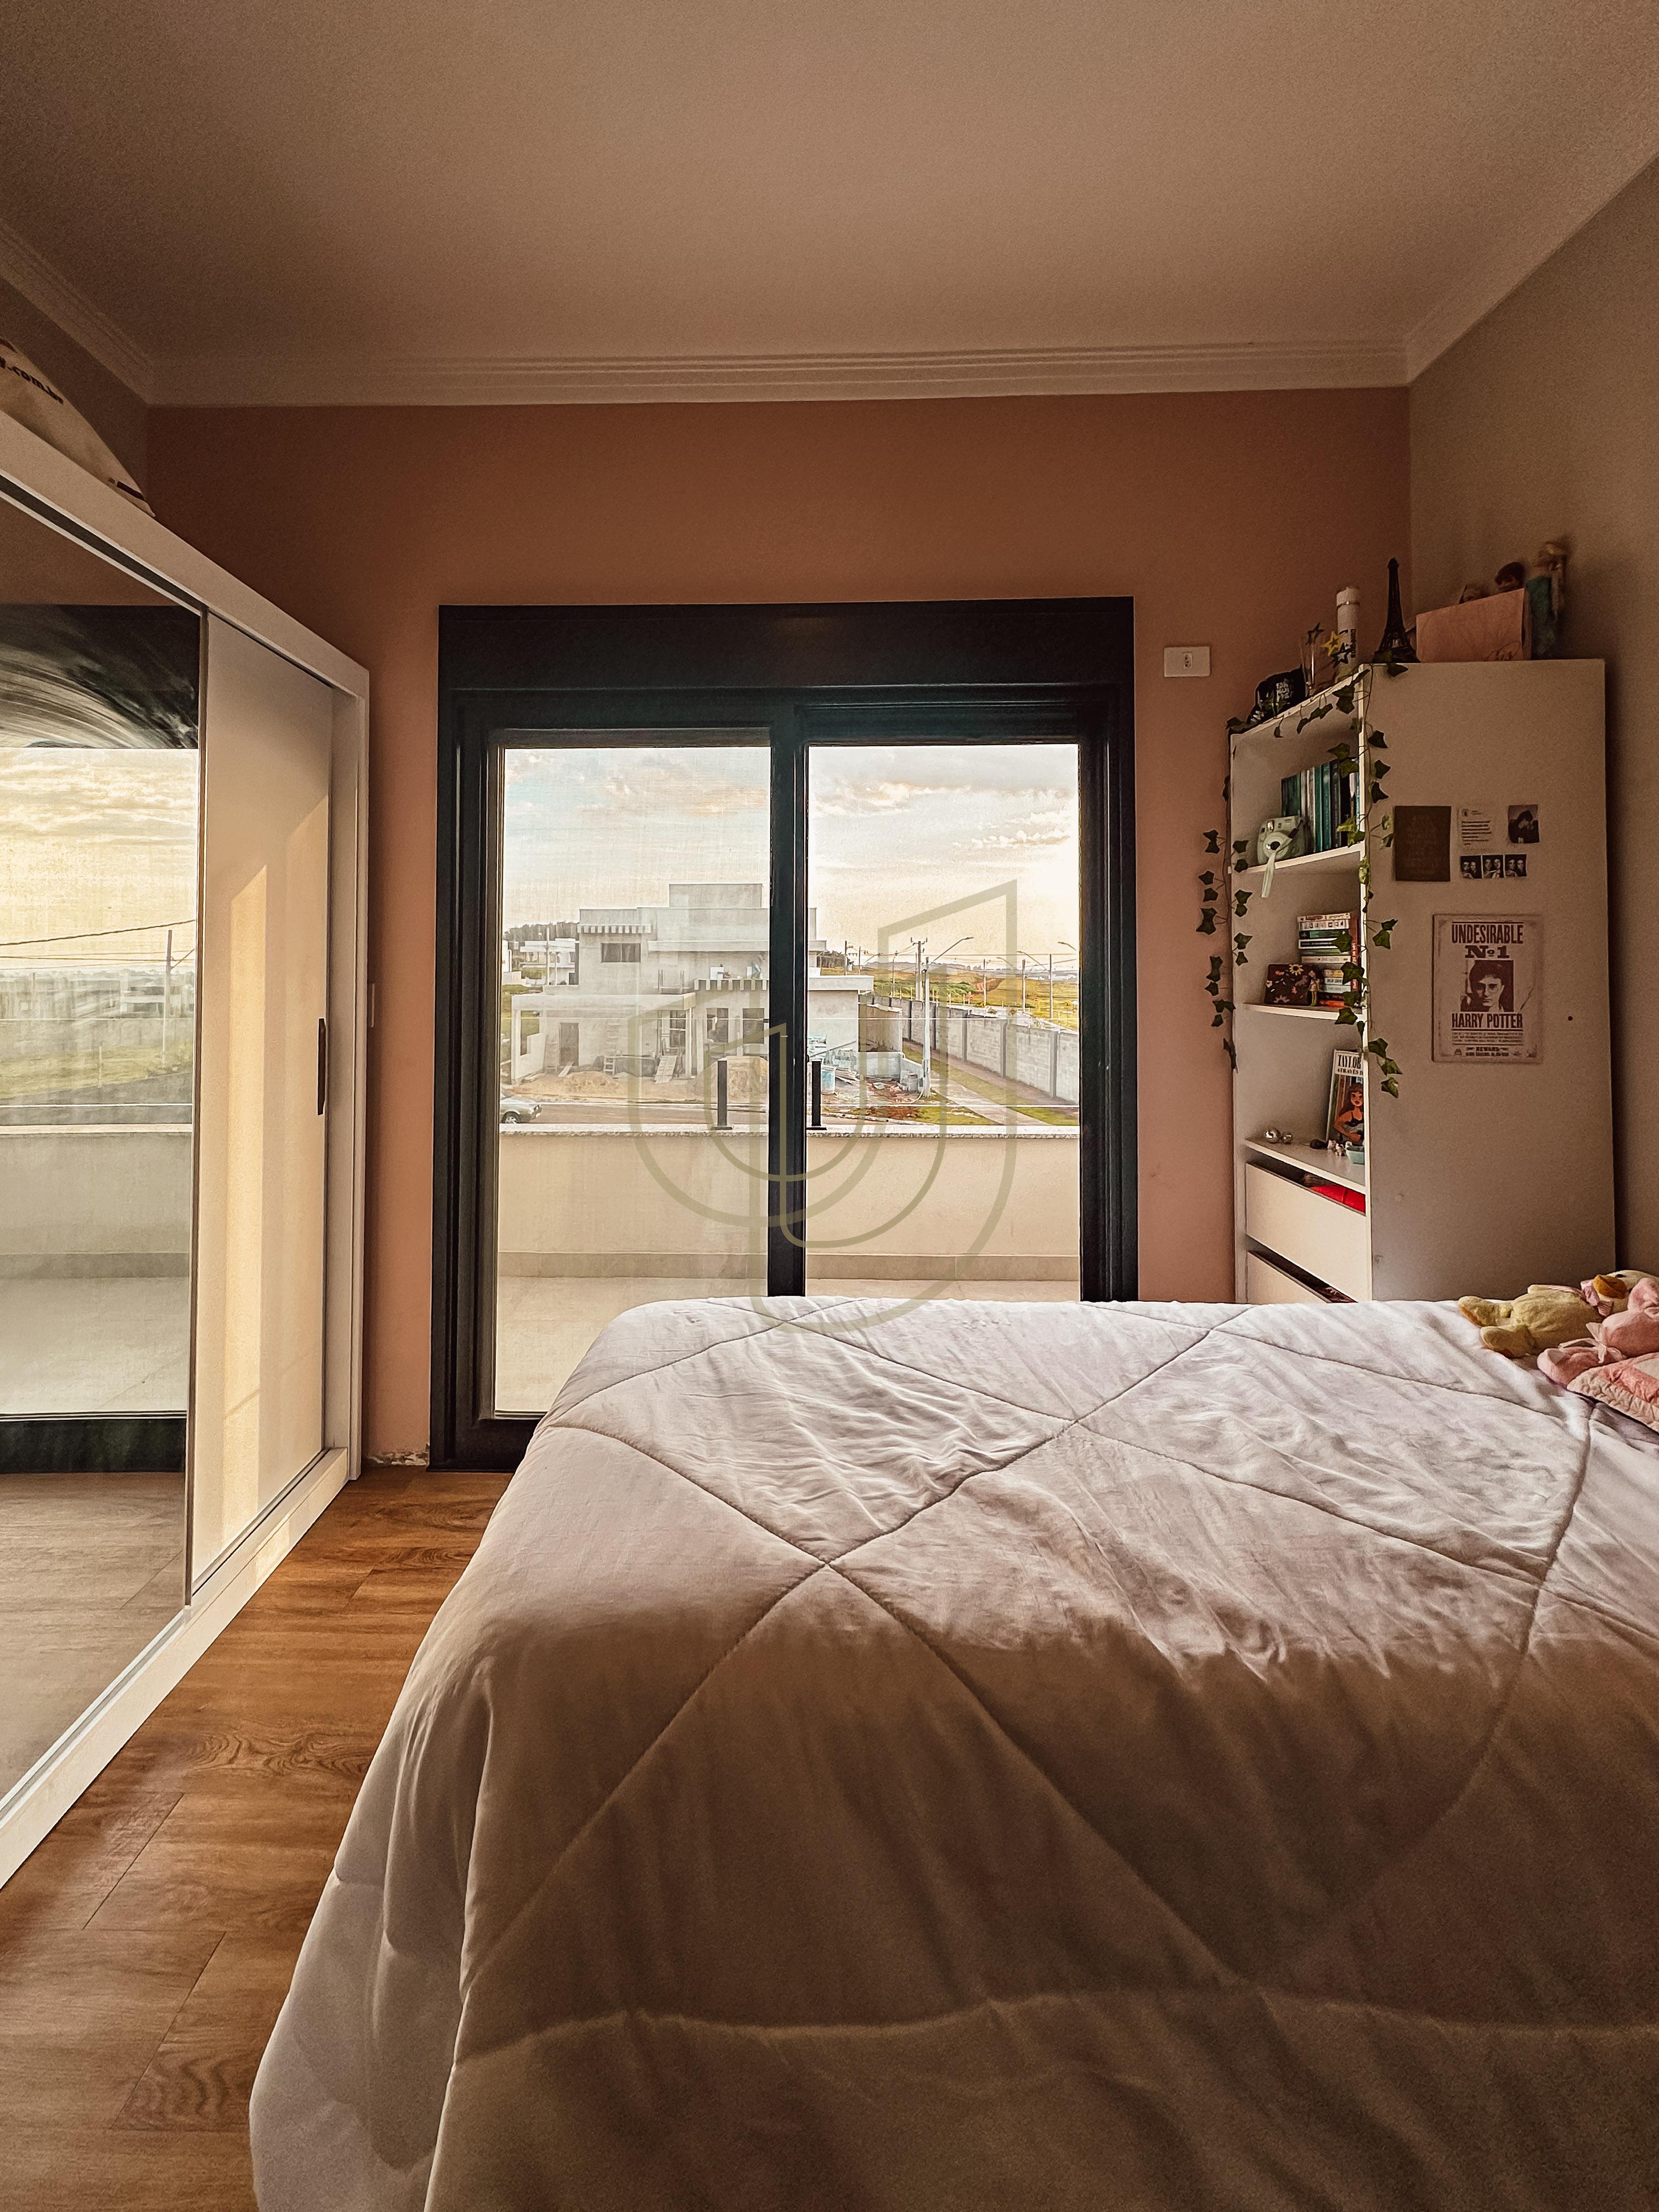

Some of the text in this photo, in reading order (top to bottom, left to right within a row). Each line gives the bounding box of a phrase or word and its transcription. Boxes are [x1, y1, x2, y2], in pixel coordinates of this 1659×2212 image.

[1452, 924, 1523, 944] UNDESIRABLE
[1452, 1013, 1523, 1028] HARRY POTTER
